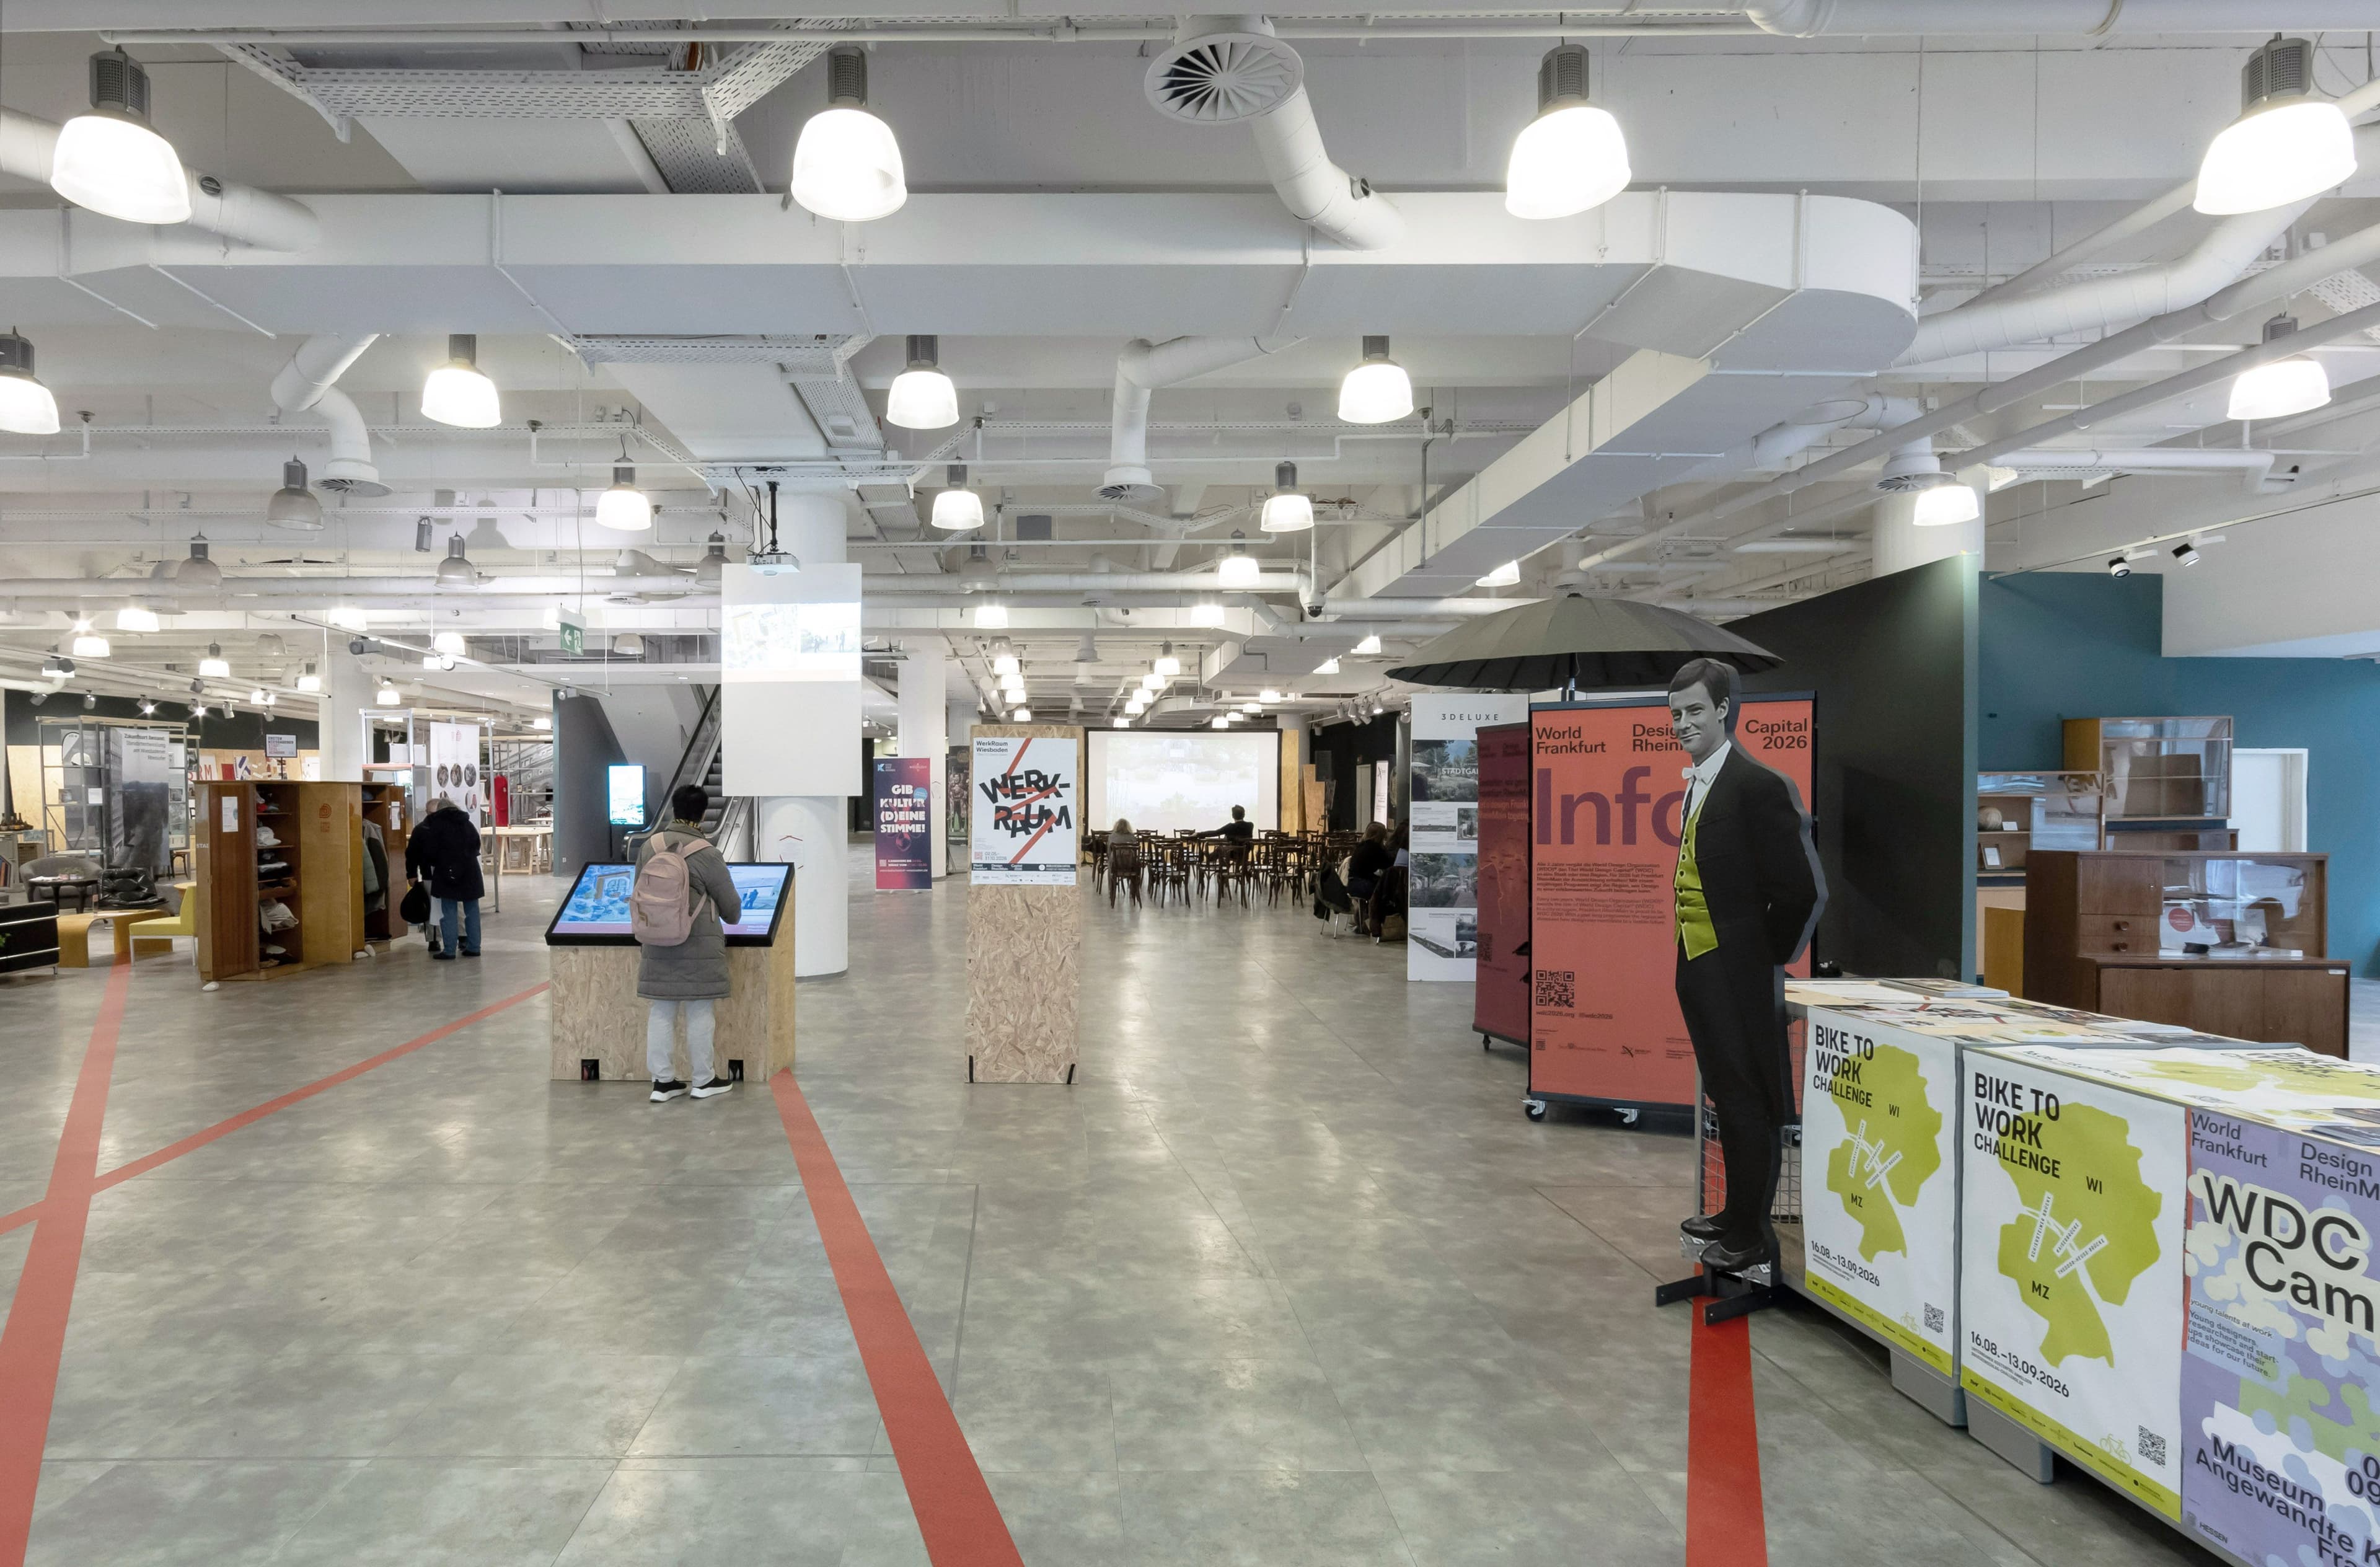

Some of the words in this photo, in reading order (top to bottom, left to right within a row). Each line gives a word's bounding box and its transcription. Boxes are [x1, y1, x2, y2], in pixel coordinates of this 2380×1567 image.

[1536, 726, 1582, 739] World
[1745, 718, 1808, 735] Capital
[1536, 740, 1606, 754] Frankfurt
[1633, 738, 1683, 752] Rhein
[1763, 735, 1808, 749] 2026
[880, 798, 925, 808] KULTUR
[891, 785, 913, 794] GIB
[880, 811, 925, 823] (D)EINE
[880, 824, 925, 832] STIMME!
[994, 803, 1072, 838] RAUM
[1536, 1010, 1575, 1018] wdc2026.org
[1815, 1024, 1849, 1054] BIKE
[1854, 1035, 1874, 1061] TO
[1815, 1049, 1862, 1085] WORK
[1813, 1075, 1872, 1108] CHALLENGE
[1975, 1072, 2023, 1111] BIKE
[2030, 1088, 2060, 1122] TO
[1889, 1104, 1900, 1118] WI
[1975, 1102, 2043, 1149] WORK
[1974, 1132, 2061, 1179] CHALLENGE
[2192, 1112, 2241, 1141] World
[2301, 1142, 2372, 1177] Design
[2192, 1132, 2268, 1167] Frankfurt
[1851, 1193, 1863, 1208] MZ
[2086, 1176, 2102, 1194] WI
[2203, 1175, 2360, 1271] WDC
[2032, 1280, 2050, 1300] MZ
[2246, 1240, 2374, 1333] Cam
[2189, 1309, 2215, 1328] Young
[2191, 1299, 2214, 1313] young
[2216, 1309, 2241, 1325] talents
[2188, 1319, 2237, 1344] researchers
[2239, 1341, 2254, 1353] and
[2188, 1328, 2203, 1338] ups
[2205, 1334, 2245, 1357] showcase
[2247, 1353, 2265, 1366] their
[2188, 1334, 2210, 1349] ideas
[2212, 1344, 2225, 1355] for
[2226, 1353, 2241, 1362] our
[2243, 1358, 2271, 1377] future.
[2213, 1436, 2323, 1512] Museum
[2196, 1447, 2353, 1552] Angewandte
[2200, 1522, 2228, 1543] HESSEN
